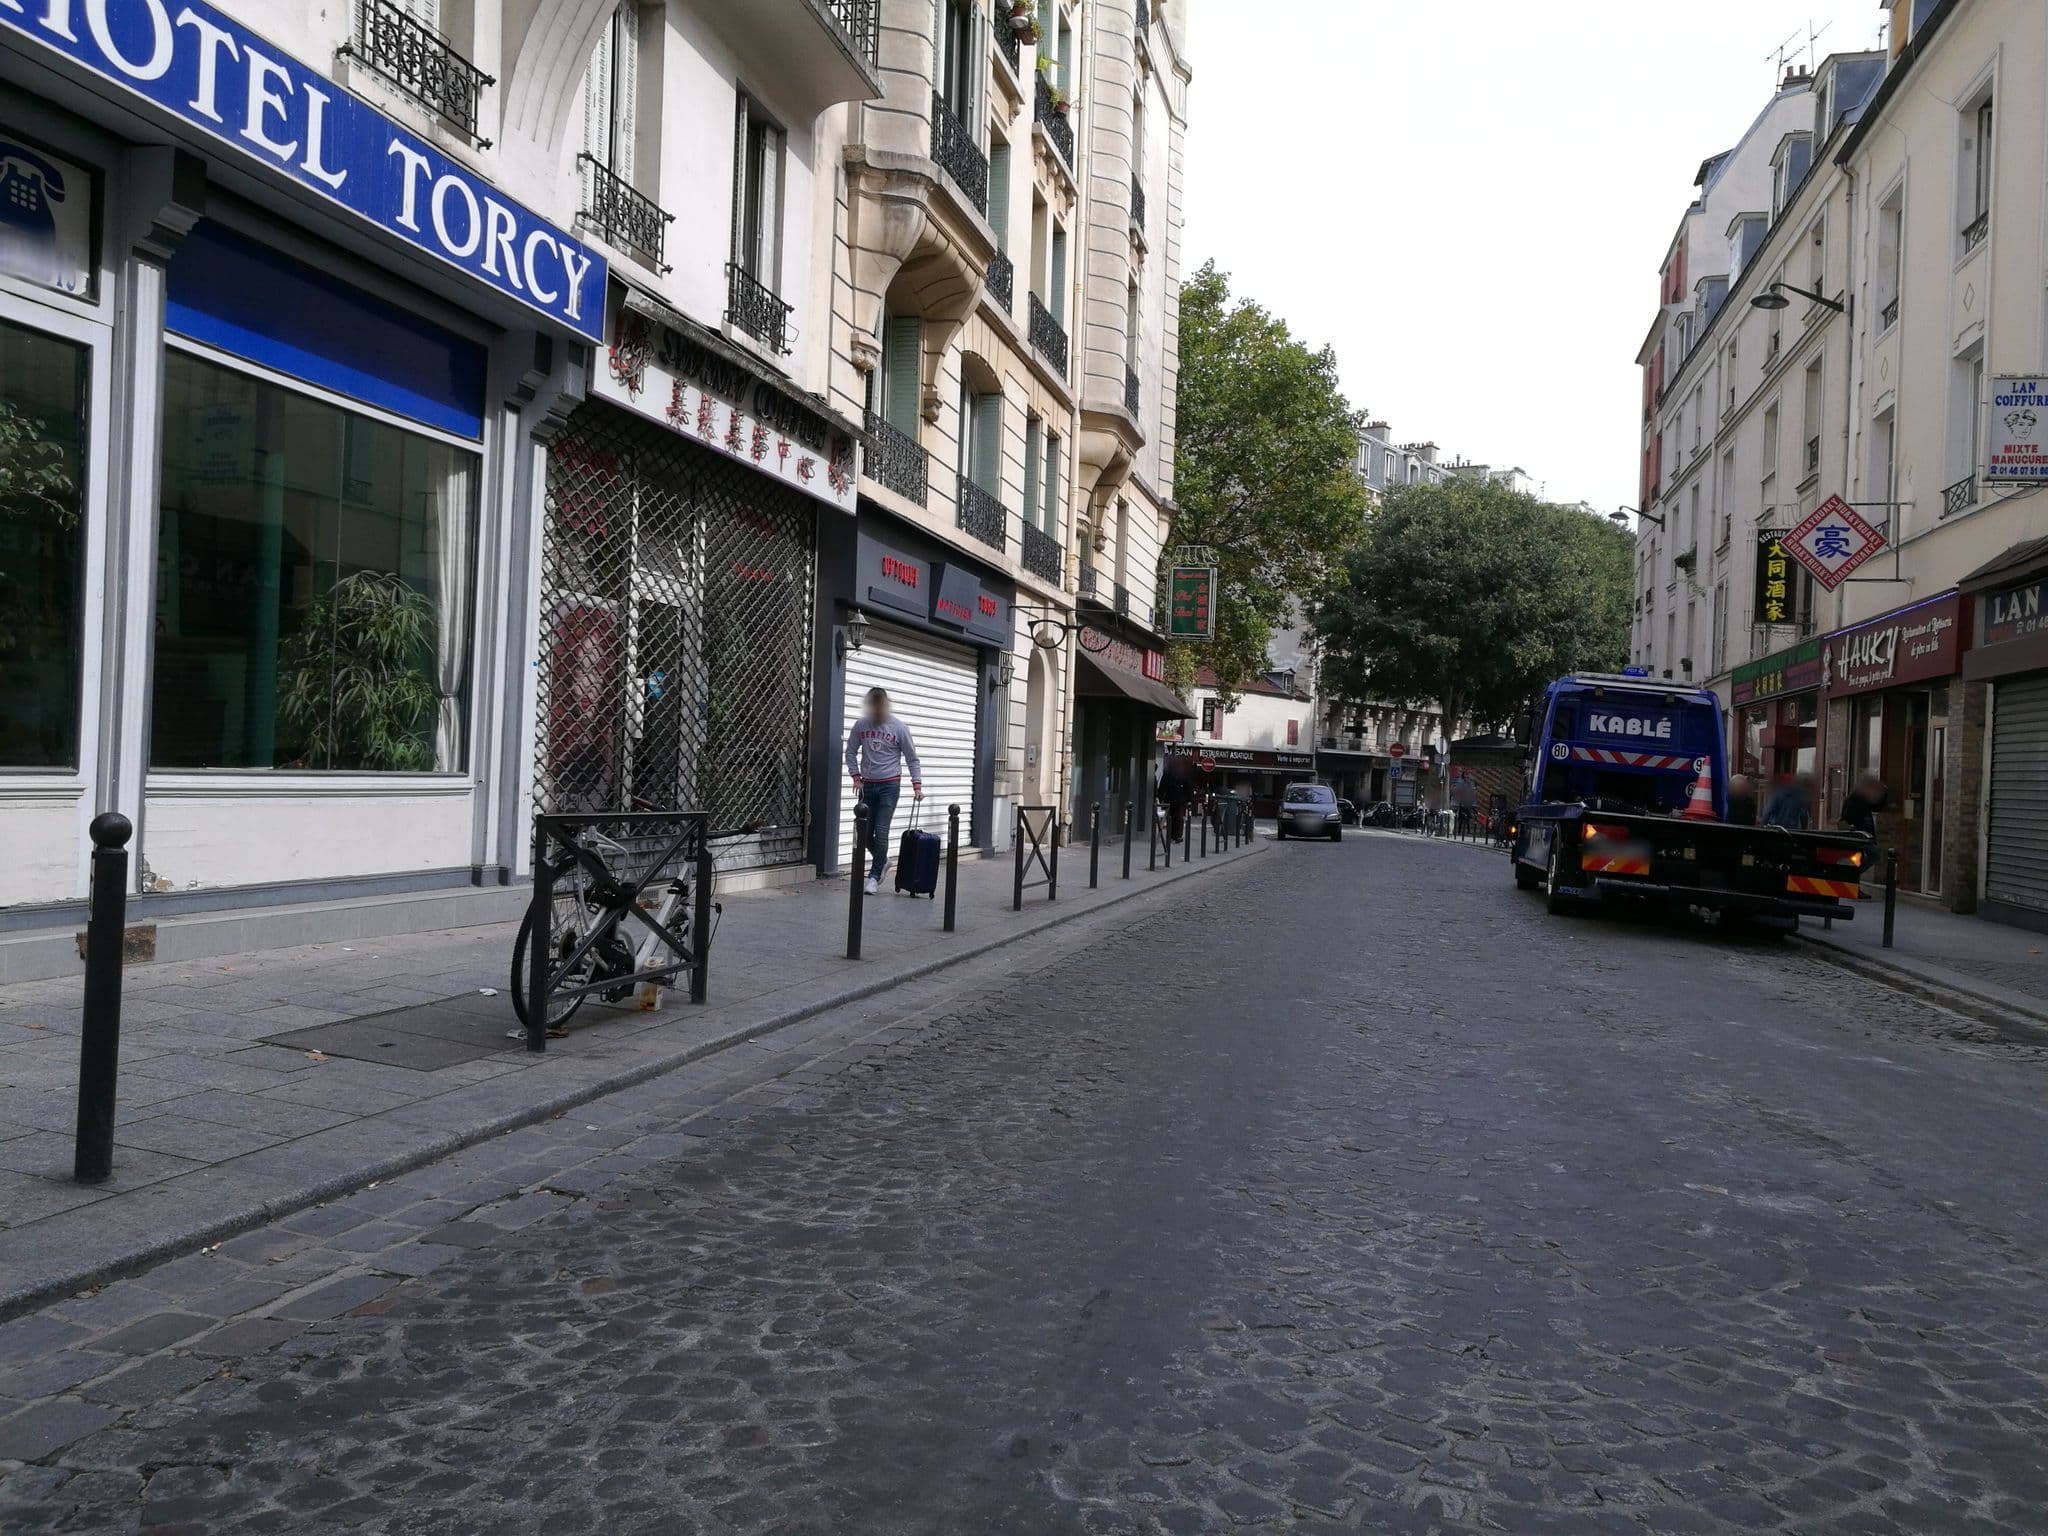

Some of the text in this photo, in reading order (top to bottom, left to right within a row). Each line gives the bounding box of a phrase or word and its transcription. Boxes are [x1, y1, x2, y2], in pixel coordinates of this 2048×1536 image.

[388, 138, 592, 320] TORCY
[2012, 382, 2036, 393] LAN
[2004, 444, 2038, 454] MIXTE
[1992, 455, 2048, 464] MANUCURE
[1815, 524, 1853, 559] 豪
[882, 555, 919, 588] OPTIQUE
[1994, 586, 2040, 624] LAN
[860, 729, 897, 744] BENFICA
[1589, 715, 1672, 739] KABLÉ
[1554, 745, 1567, 758] 80
